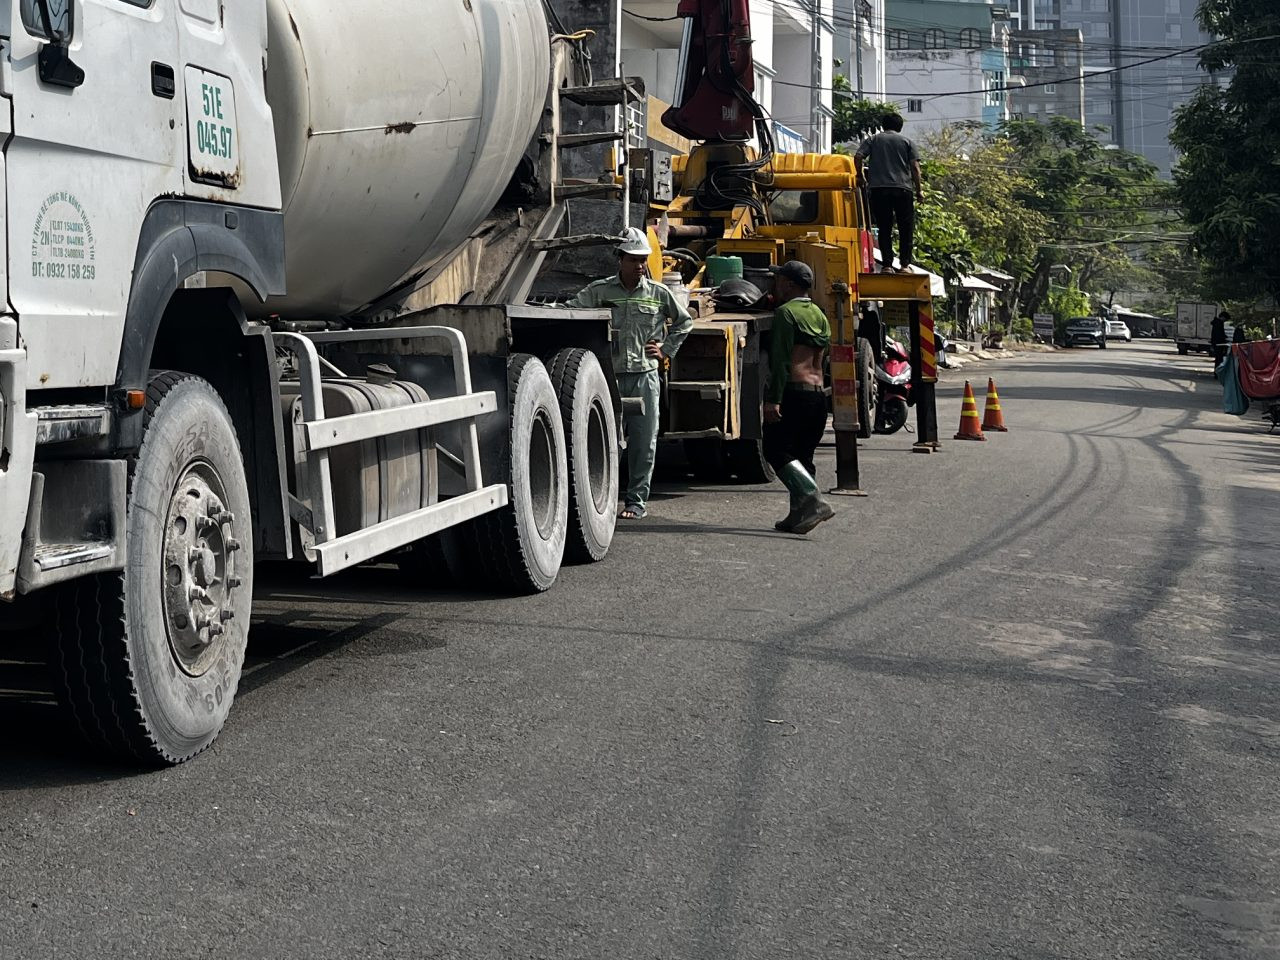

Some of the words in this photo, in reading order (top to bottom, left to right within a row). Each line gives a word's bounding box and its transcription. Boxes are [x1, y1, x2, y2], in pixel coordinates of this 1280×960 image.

[201, 83, 224, 120] 51E
[196, 120, 233, 159] 045.97
[46, 262, 65, 279] 0932
[67, 263, 81, 279] 158
[82, 264, 96, 280] 259
